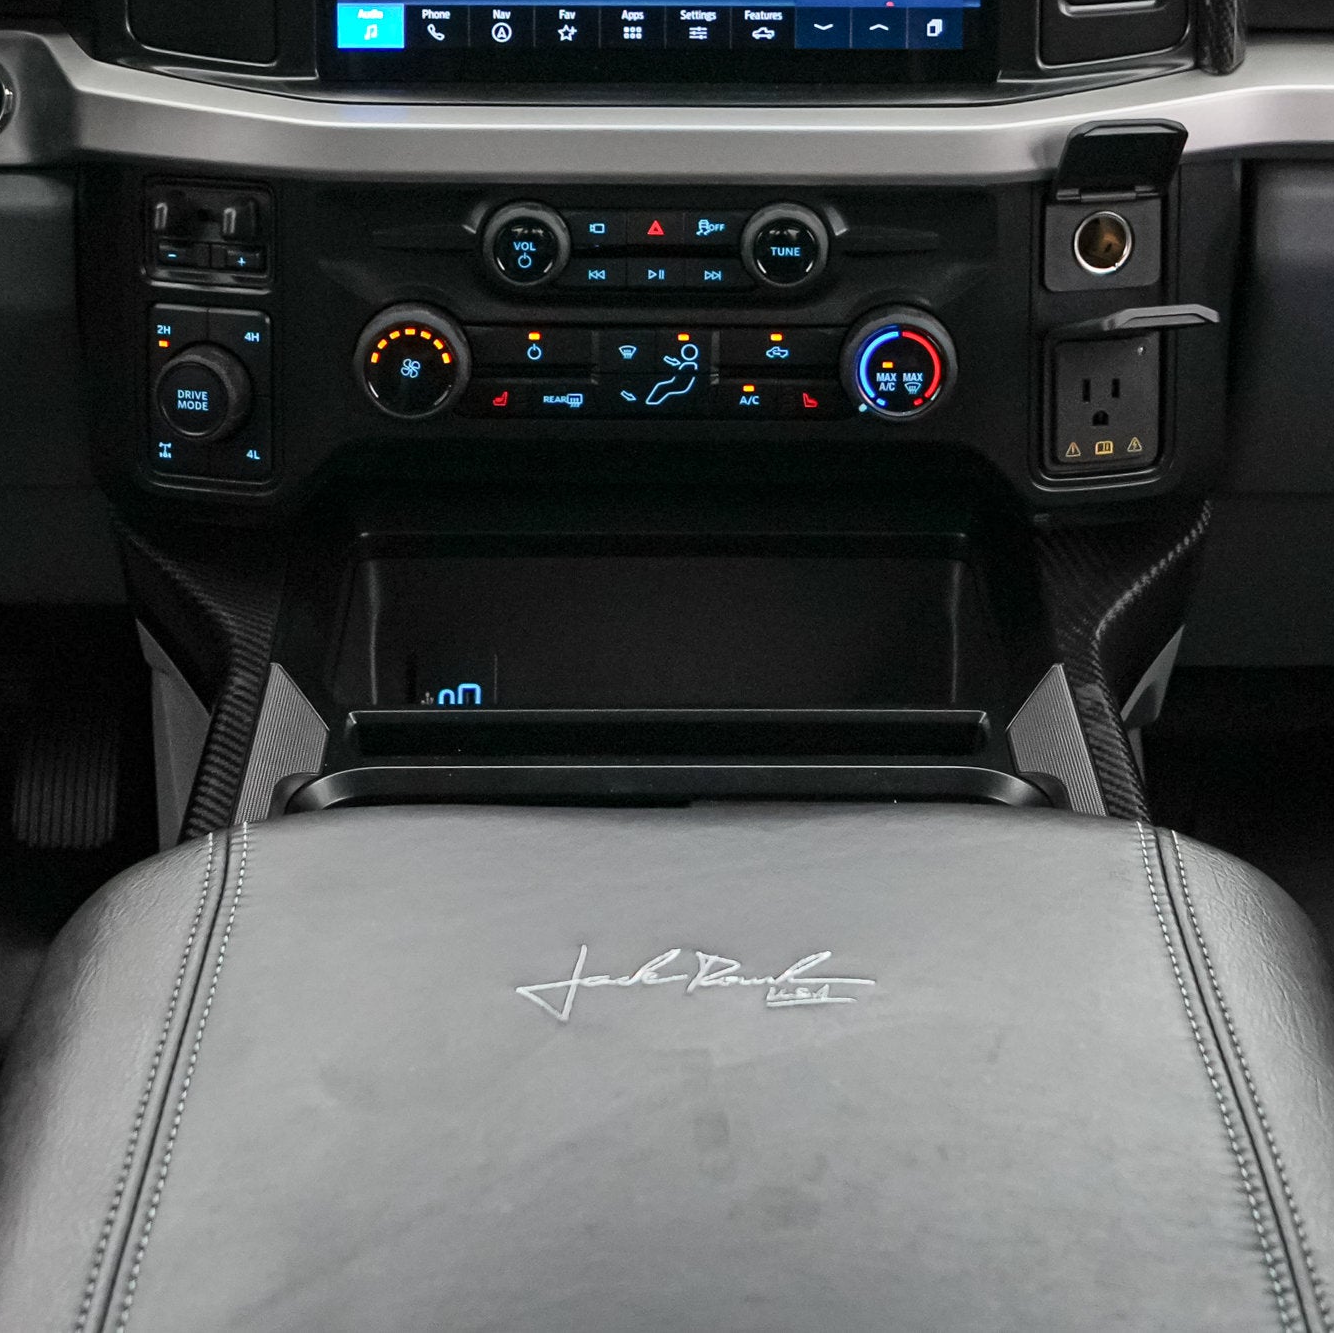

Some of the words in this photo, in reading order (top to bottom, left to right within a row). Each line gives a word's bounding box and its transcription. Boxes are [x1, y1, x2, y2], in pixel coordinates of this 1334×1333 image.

[357, 9, 383, 20] Audio
[421, 8, 451, 20] Phone
[492, 8, 512, 20] Nav
[559, 8, 577, 20] Fav
[621, 9, 644, 23] Apps
[680, 9, 717, 23] Settings
[744, 9, 783, 21] Features
[708, 223, 725, 233] OFF
[513, 241, 537, 252] VOL
[770, 247, 801, 257] TUNE
[156, 324, 171, 335] 2H
[244, 332, 260, 343] 4H
[875, 372, 897, 382] MAX
[902, 372, 924, 382] MAX
[878, 382, 895, 392] A/C
[177, 389, 208, 401] DRIVE
[543, 395, 568, 405] REAR
[177, 399, 209, 411] MODE
[738, 395, 760, 407] A/C
[246, 449, 261, 460] 4L
